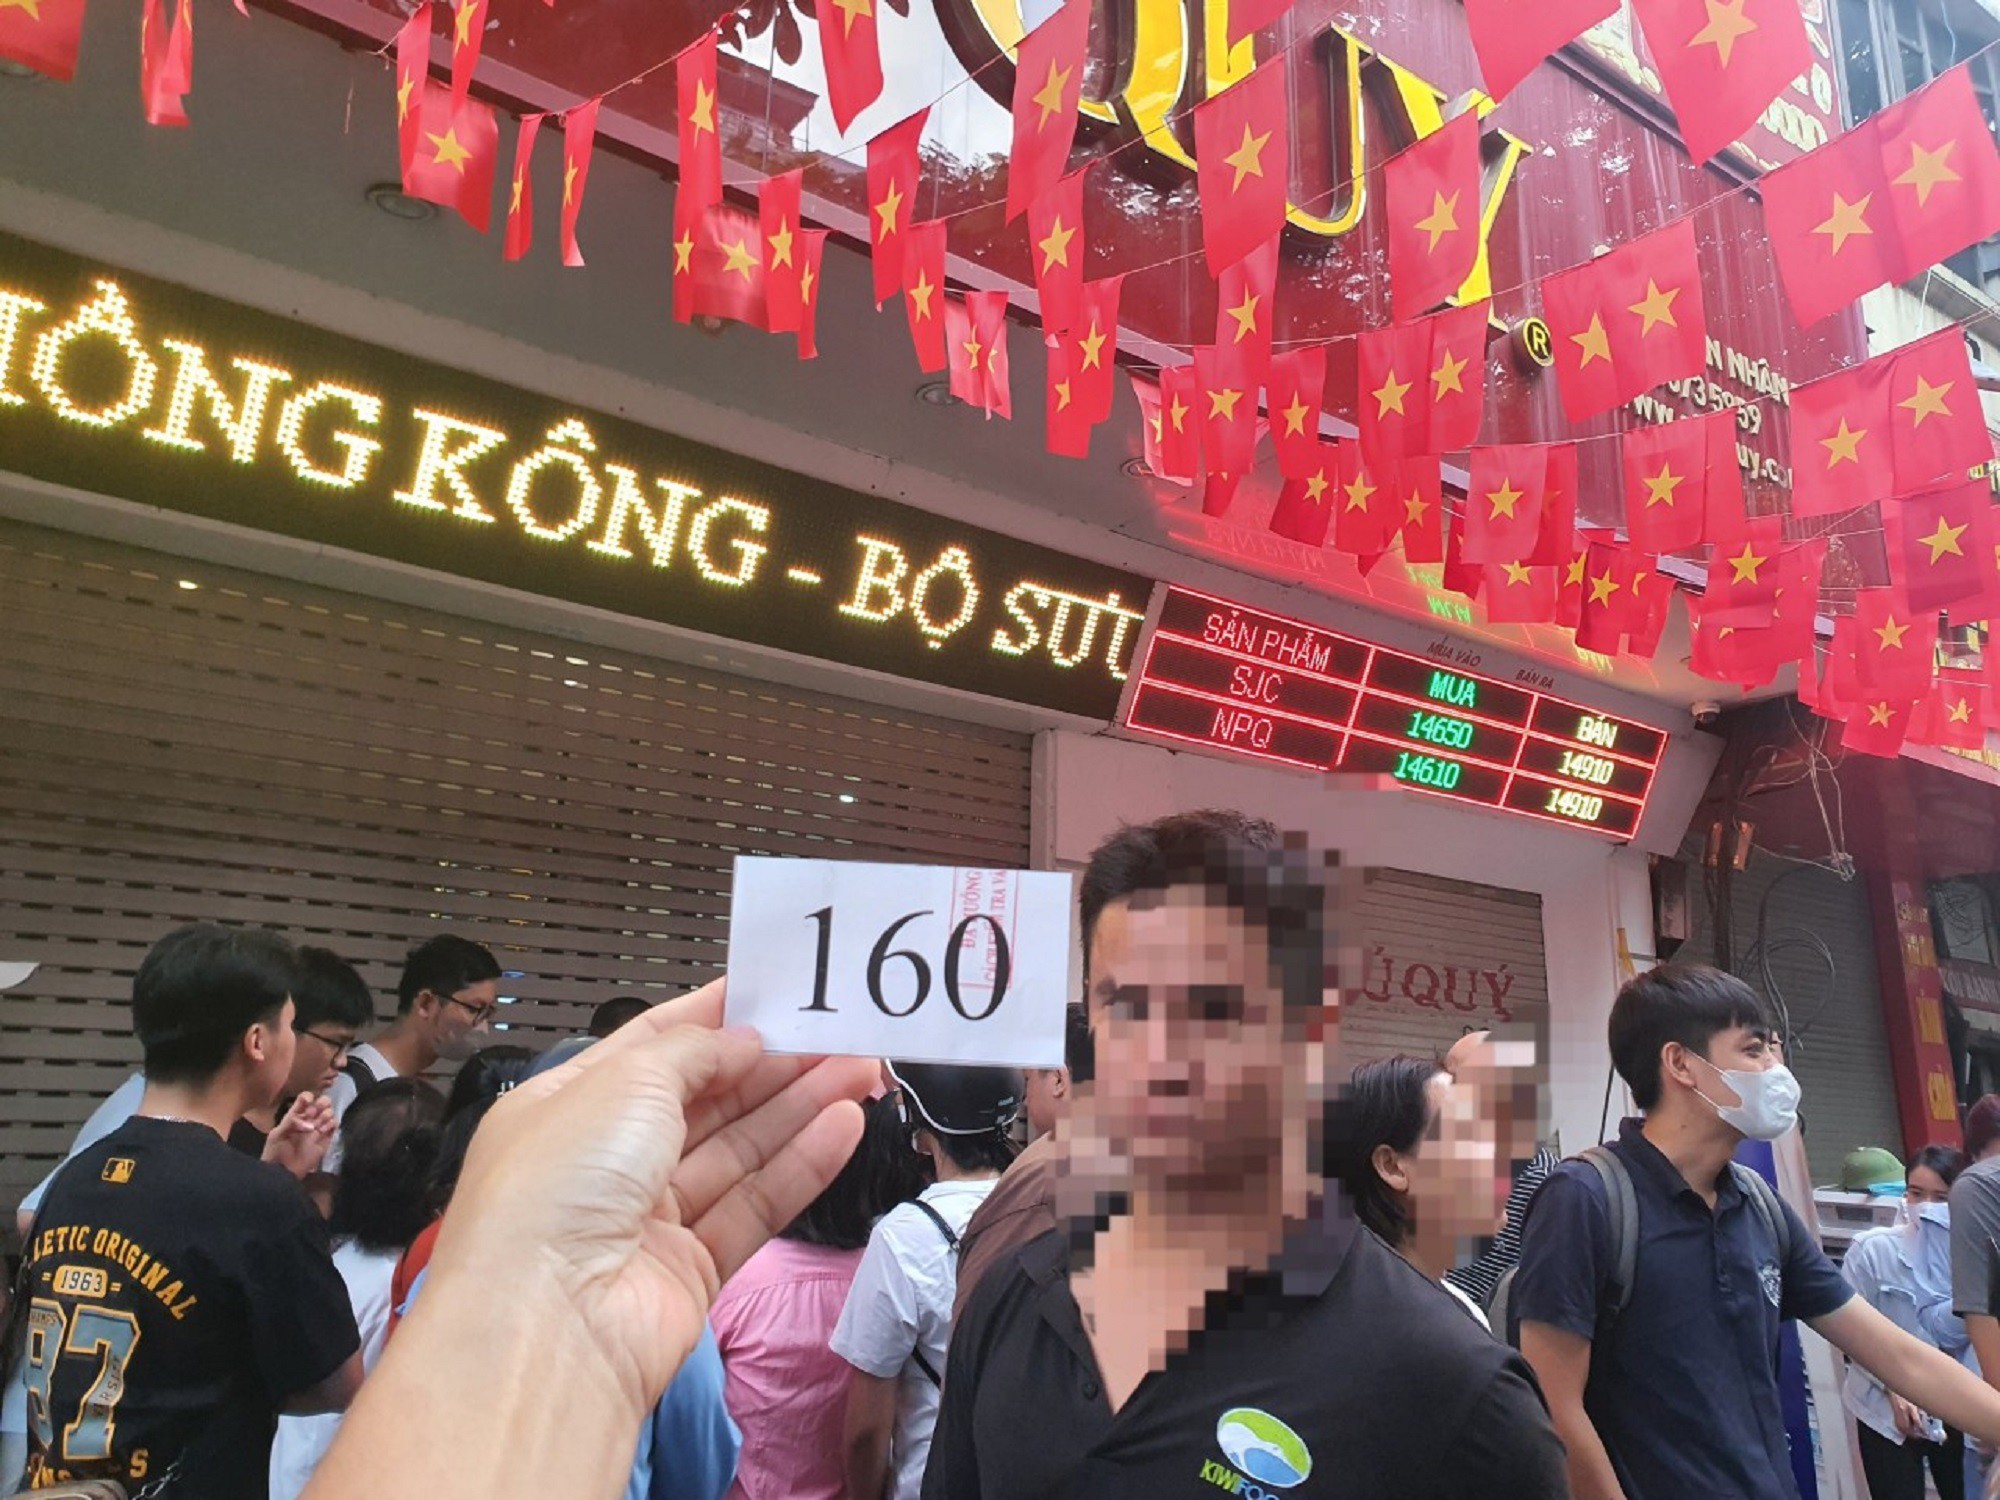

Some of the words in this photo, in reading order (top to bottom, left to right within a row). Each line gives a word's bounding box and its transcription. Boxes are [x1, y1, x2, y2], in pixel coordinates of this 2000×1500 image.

[393, 409, 772, 587] KÔNG
[838, 535, 981, 649] BỘ
[1229, 665, 1284, 704] SJC
[1427, 671, 1477, 709] MUA
[1210, 708, 1274, 749] NPQ
[1406, 711, 1474, 749] 14650
[1576, 713, 1618, 750] BÁN
[1393, 752, 1461, 789] 14610
[1557, 751, 1615, 786] 14910
[1544, 788, 1604, 822] 14910
[798, 905, 1011, 1021] 160
[32, 1224, 91, 1263] LETIC
[93, 1226, 199, 1321] ORIGINAL
[60, 1268, 103, 1293] 1963
